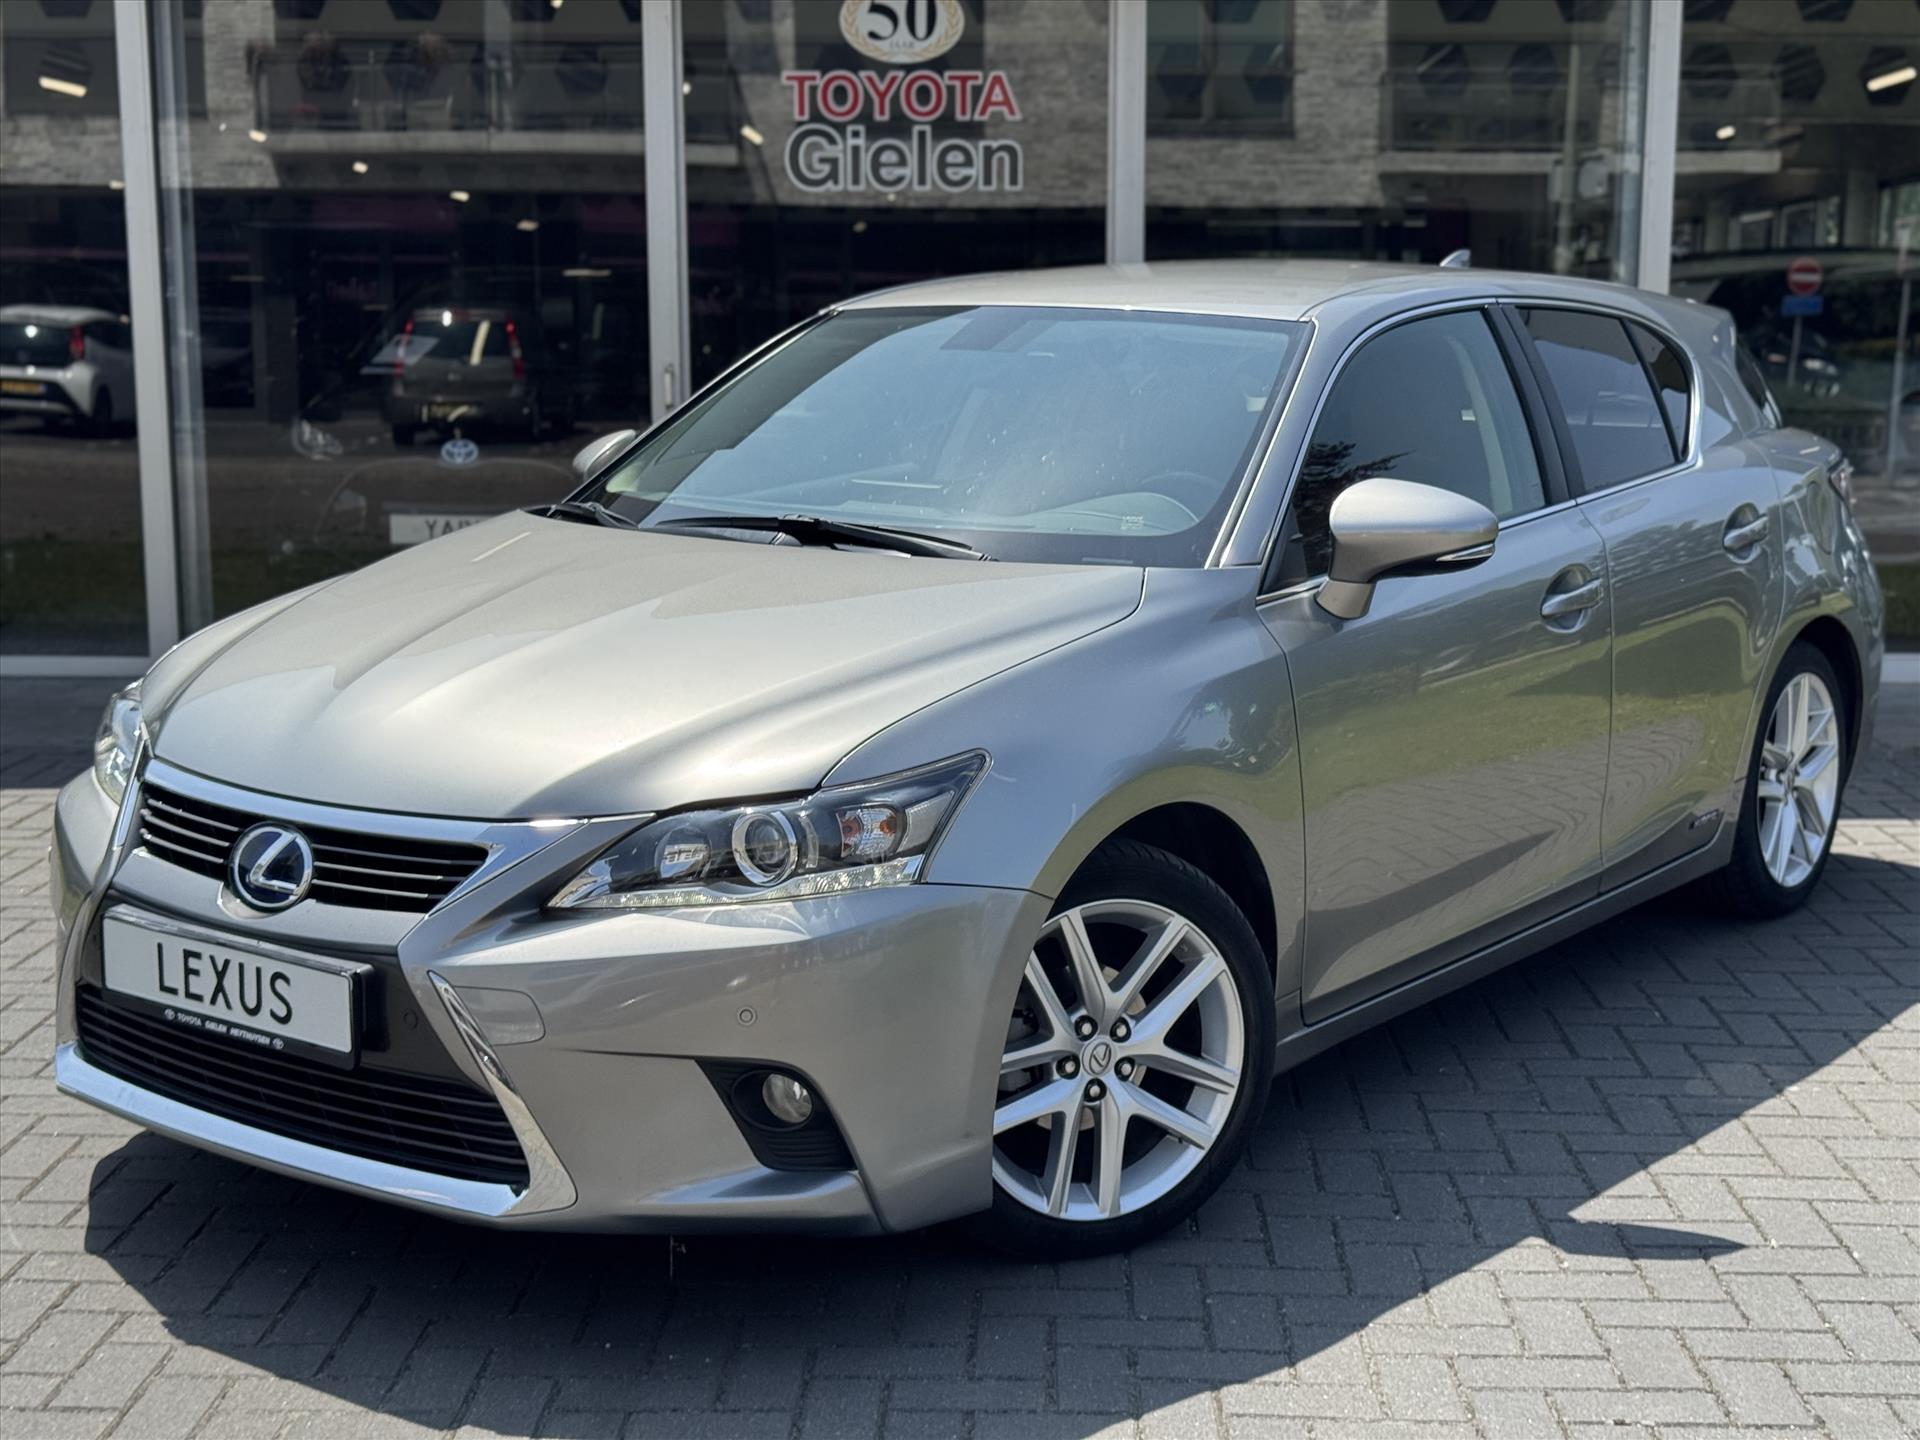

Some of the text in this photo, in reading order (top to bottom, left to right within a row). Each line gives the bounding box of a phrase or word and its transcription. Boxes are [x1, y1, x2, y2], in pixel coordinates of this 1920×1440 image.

[867, 0, 938, 41] 50
[782, 71, 1022, 121] TOYOTA
[785, 124, 1023, 192] Gielen
[157, 942, 293, 1025] LEXUS
[177, 1012, 202, 1026] TOYOTA
